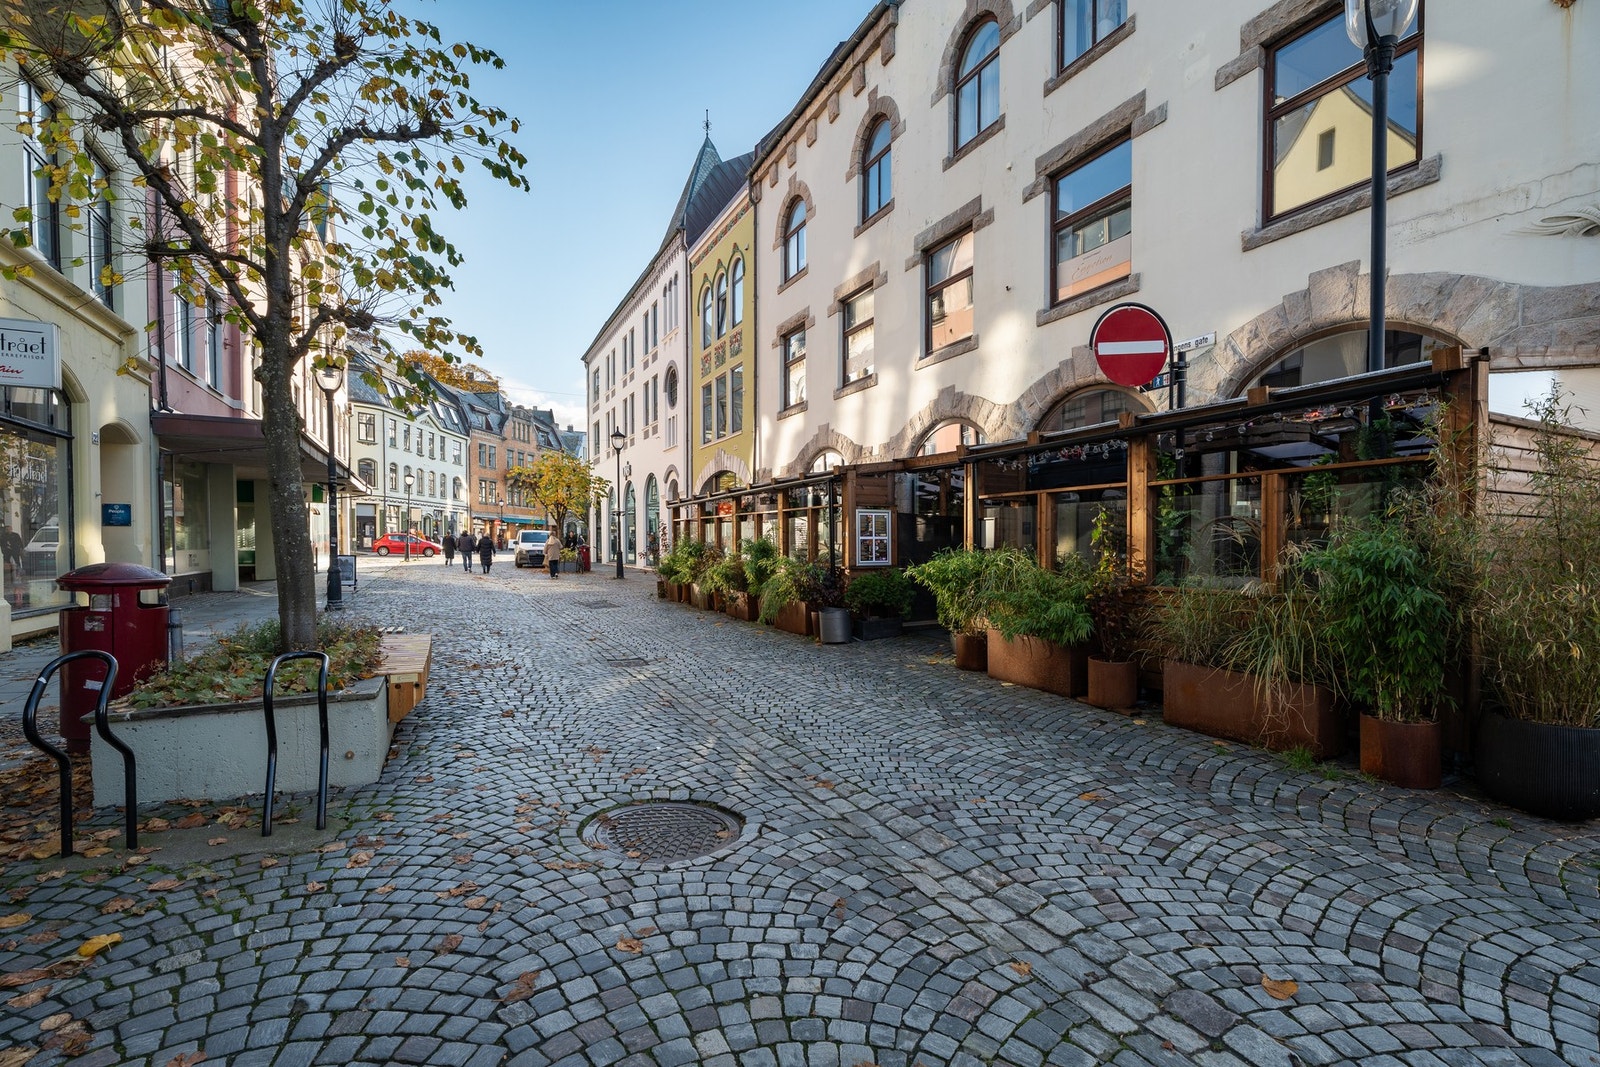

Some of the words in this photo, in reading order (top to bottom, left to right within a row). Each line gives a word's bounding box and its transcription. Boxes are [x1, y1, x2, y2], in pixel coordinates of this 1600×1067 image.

[0, 333, 47, 354] trået
[1173, 341, 1191, 352] ngens
[1194, 336, 1209, 348] gate
